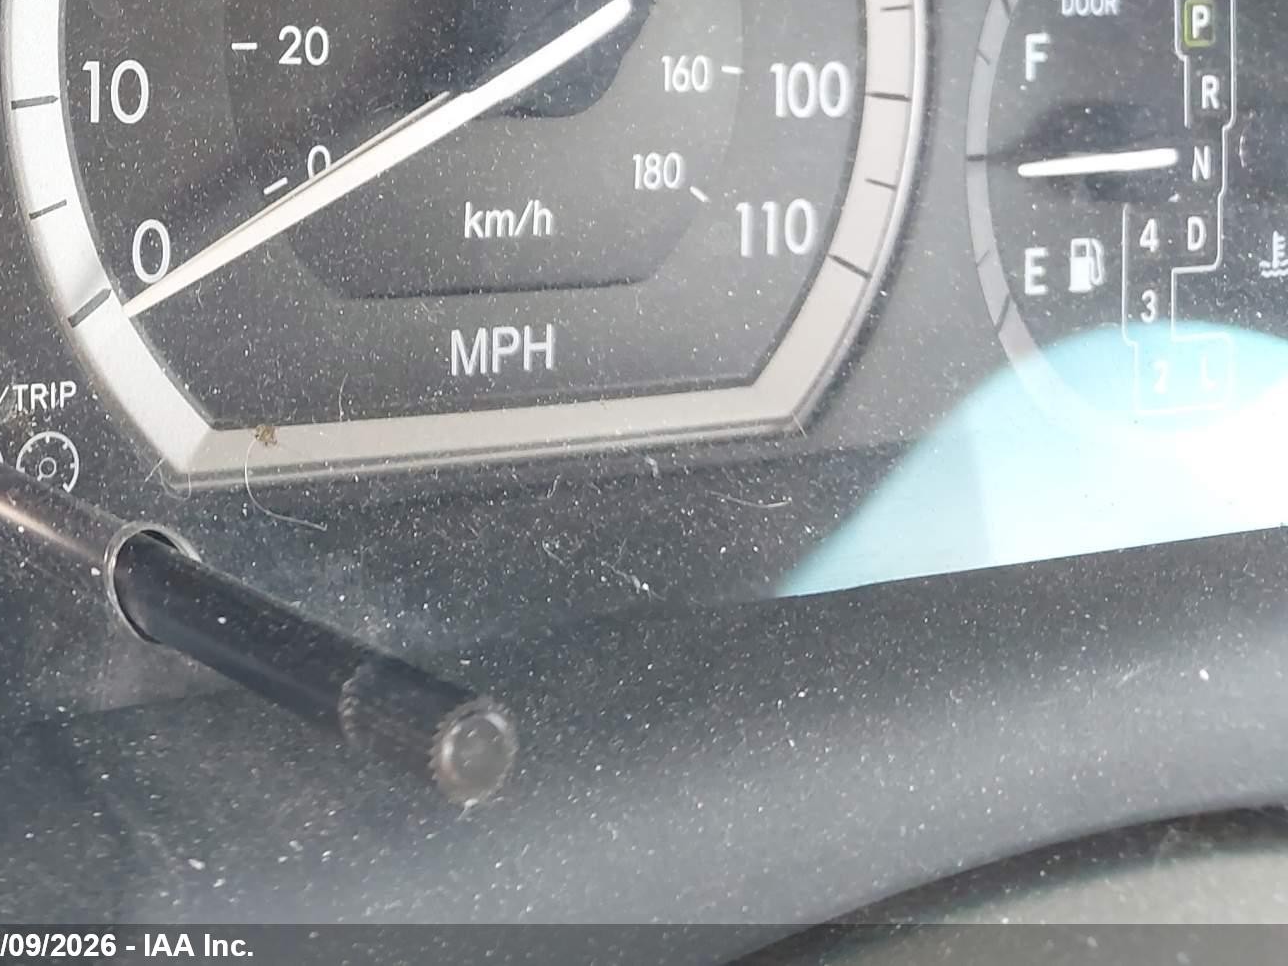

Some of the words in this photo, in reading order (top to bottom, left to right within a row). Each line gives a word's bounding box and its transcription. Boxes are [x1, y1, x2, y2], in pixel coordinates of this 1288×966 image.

[1191, 4, 1211, 39] P
[278, 25, 330, 66] 20
[1025, 32, 1051, 81] F
[82, 59, 150, 124] 10
[662, 54, 711, 93] 160
[770, 62, 850, 119] 100
[1201, 75, 1220, 109] R
[633, 153, 683, 189] 180
[1192, 146, 1211, 181] N
[464, 200, 553, 238] km/h
[735, 199, 814, 257] 110
[1139, 218, 1159, 252] 4
[1187, 216, 1206, 251] D
[132, 219, 171, 284] 0
[1024, 247, 1048, 295] E
[1141, 290, 1158, 323] 3
[451, 323, 555, 376] MPH
